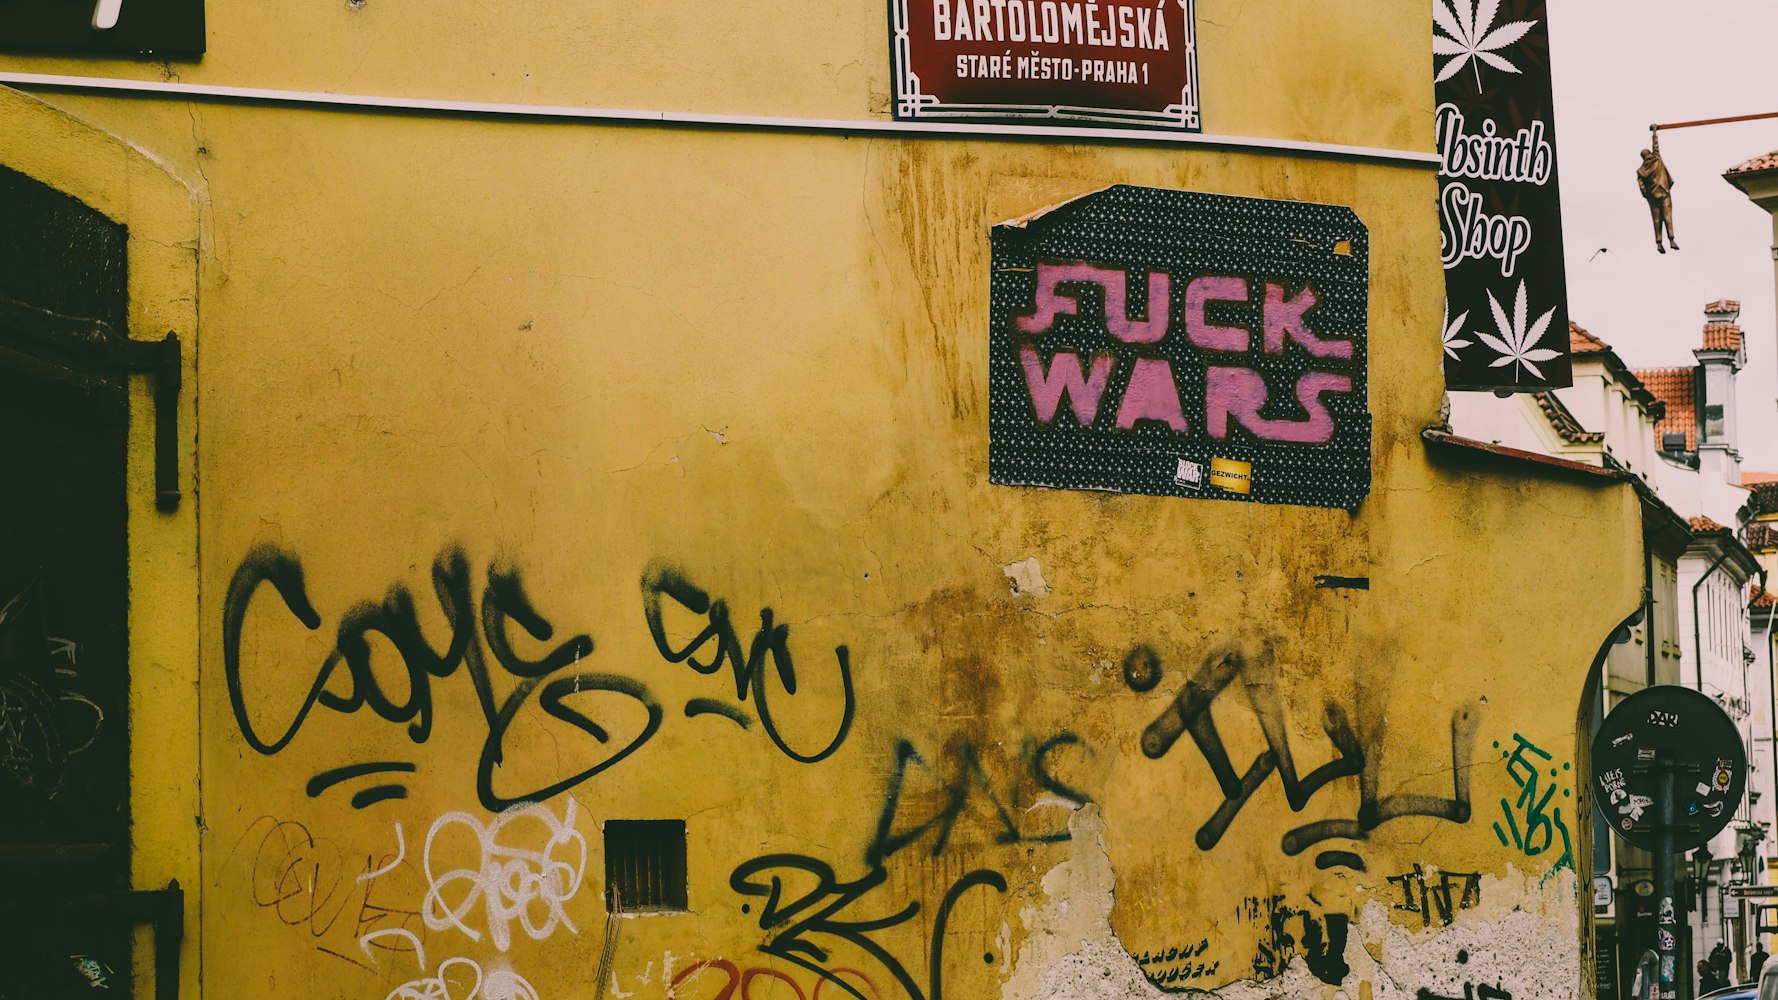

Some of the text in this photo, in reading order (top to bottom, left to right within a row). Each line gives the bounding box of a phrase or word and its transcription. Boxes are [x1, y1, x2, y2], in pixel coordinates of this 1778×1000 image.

[934, 0, 1169, 51] BARTOLOMĚJSKÁ
[956, 50, 1012, 79] STARÉ
[1141, 62, 1149, 85] 1
[1440, 182, 1531, 277] Shop
[1016, 261, 1354, 360] FUCK
[1020, 345, 1352, 443] WARS
